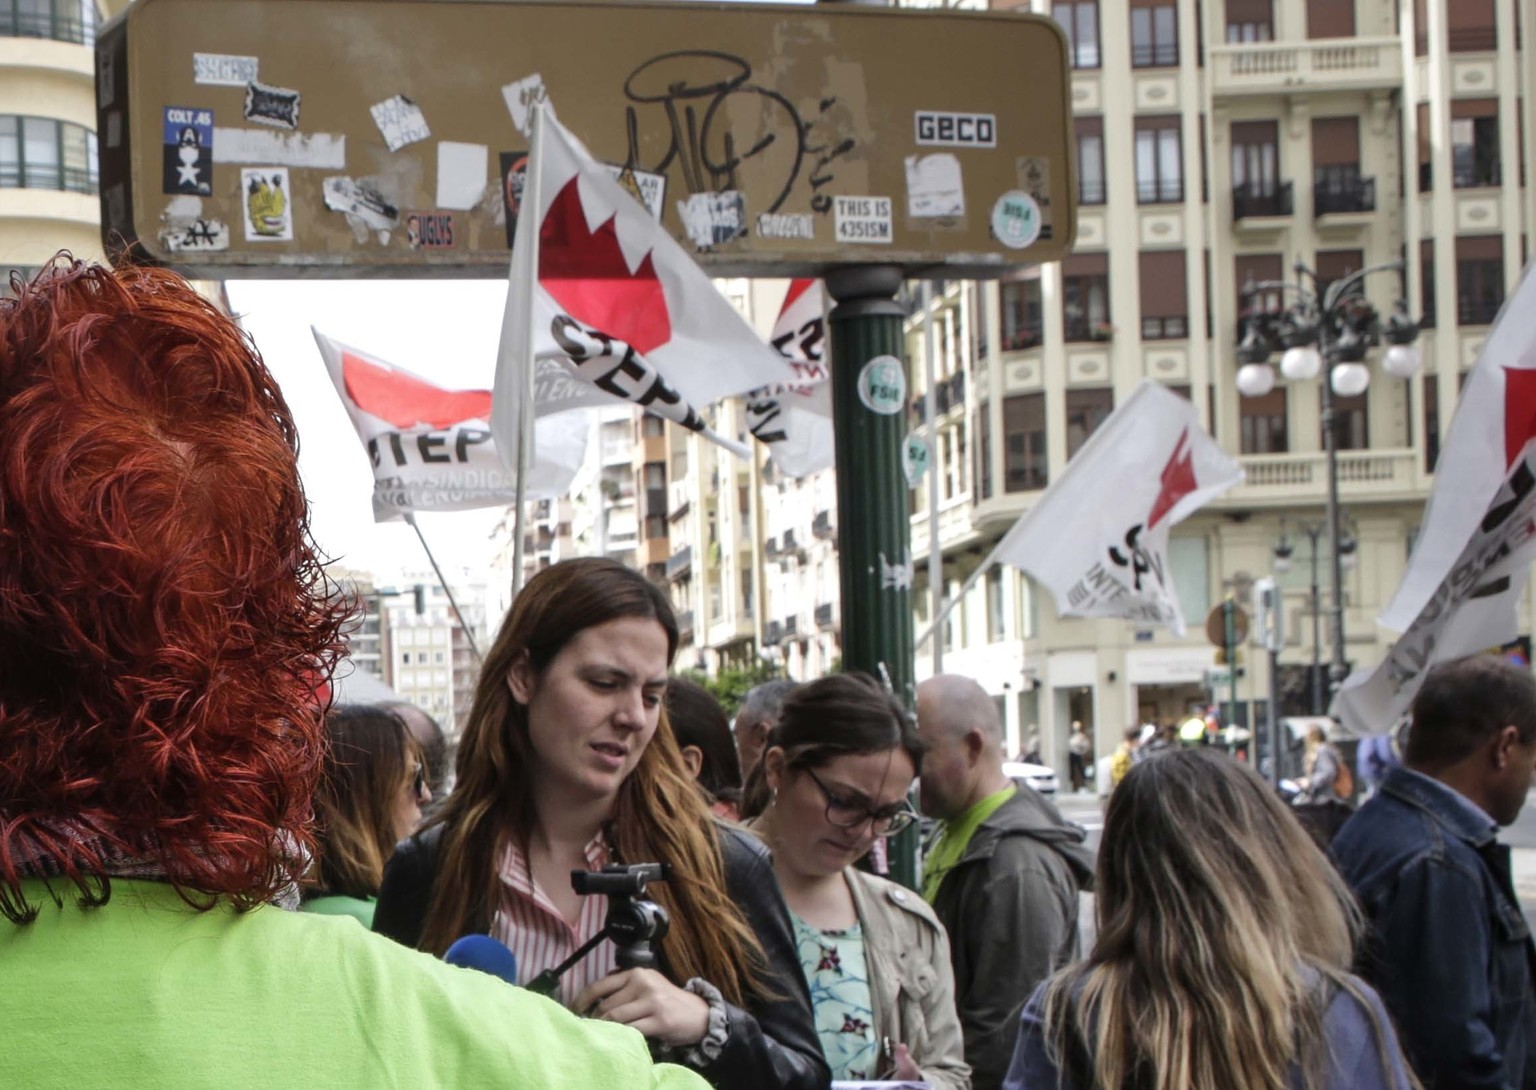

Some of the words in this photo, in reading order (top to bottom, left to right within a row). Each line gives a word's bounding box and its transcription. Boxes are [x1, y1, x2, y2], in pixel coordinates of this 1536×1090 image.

[167, 109, 193, 124] COLT
[838, 201, 869, 217] THIS
[875, 203, 889, 217] IS
[418, 215, 452, 246] UGLYS
